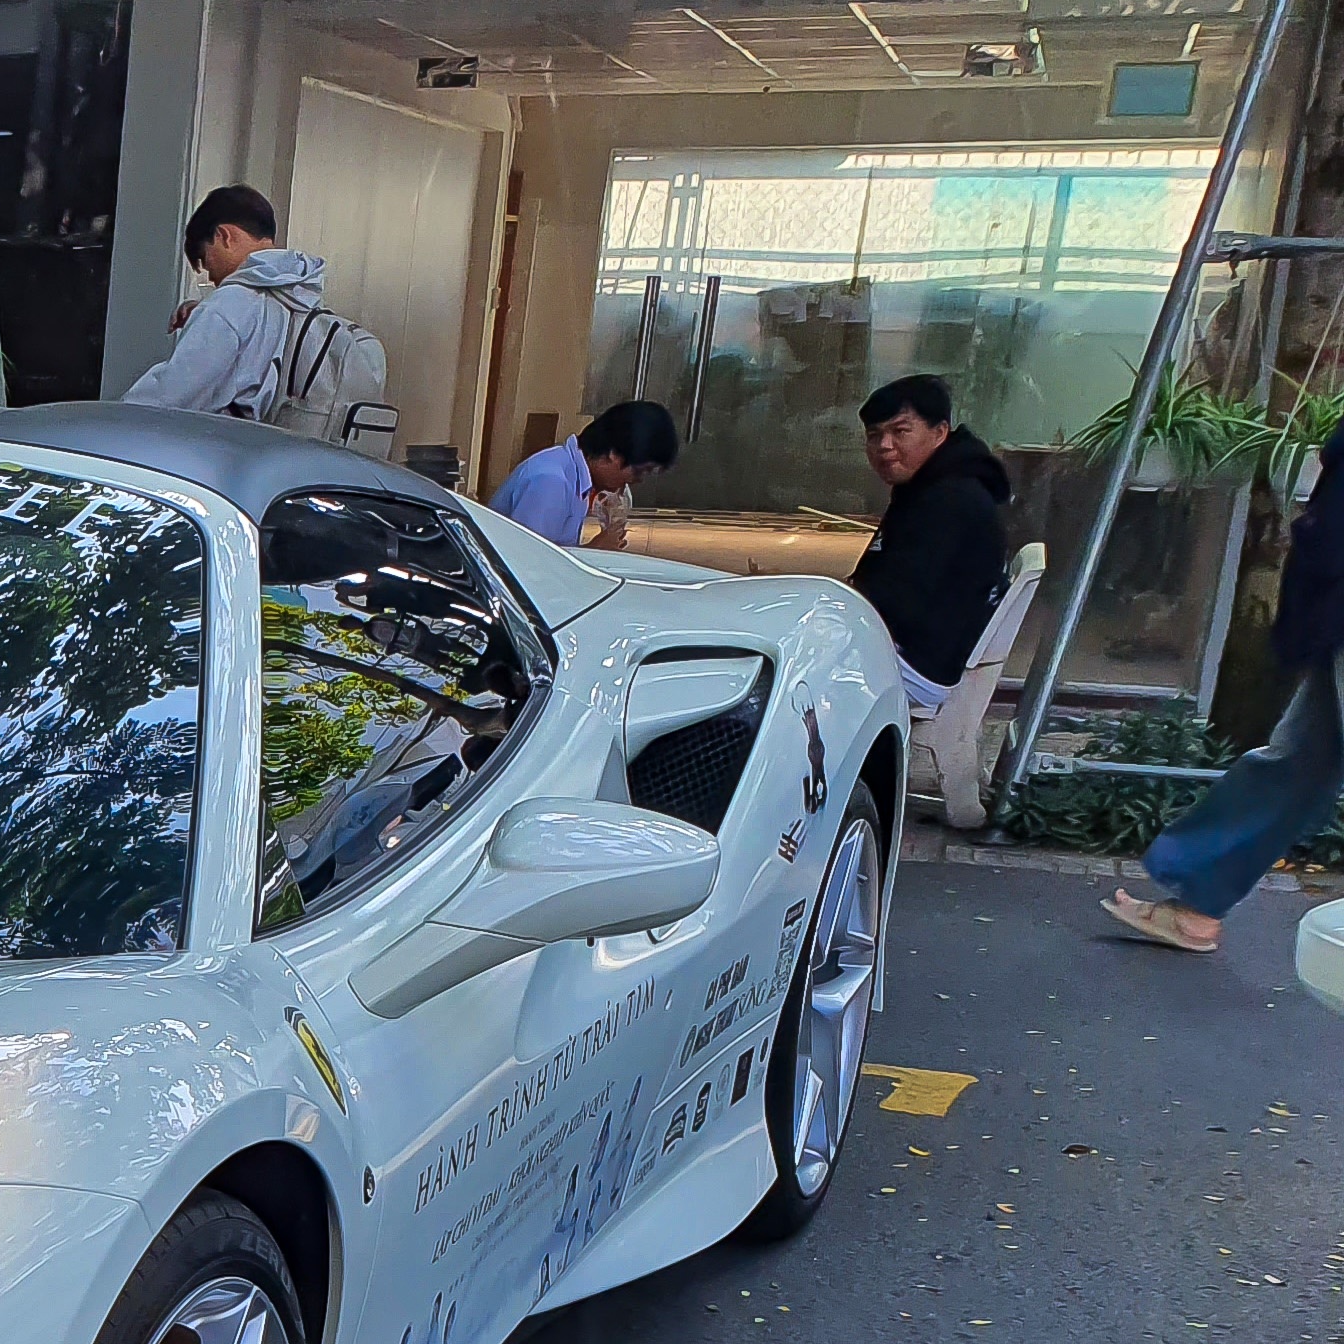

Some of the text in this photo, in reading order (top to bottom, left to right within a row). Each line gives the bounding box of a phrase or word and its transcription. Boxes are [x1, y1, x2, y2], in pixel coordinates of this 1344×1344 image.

[414, 1122, 480, 1215] HÀNH
[485, 1063, 549, 1149] TRÌNH
[626, 975, 655, 1027] TIM
